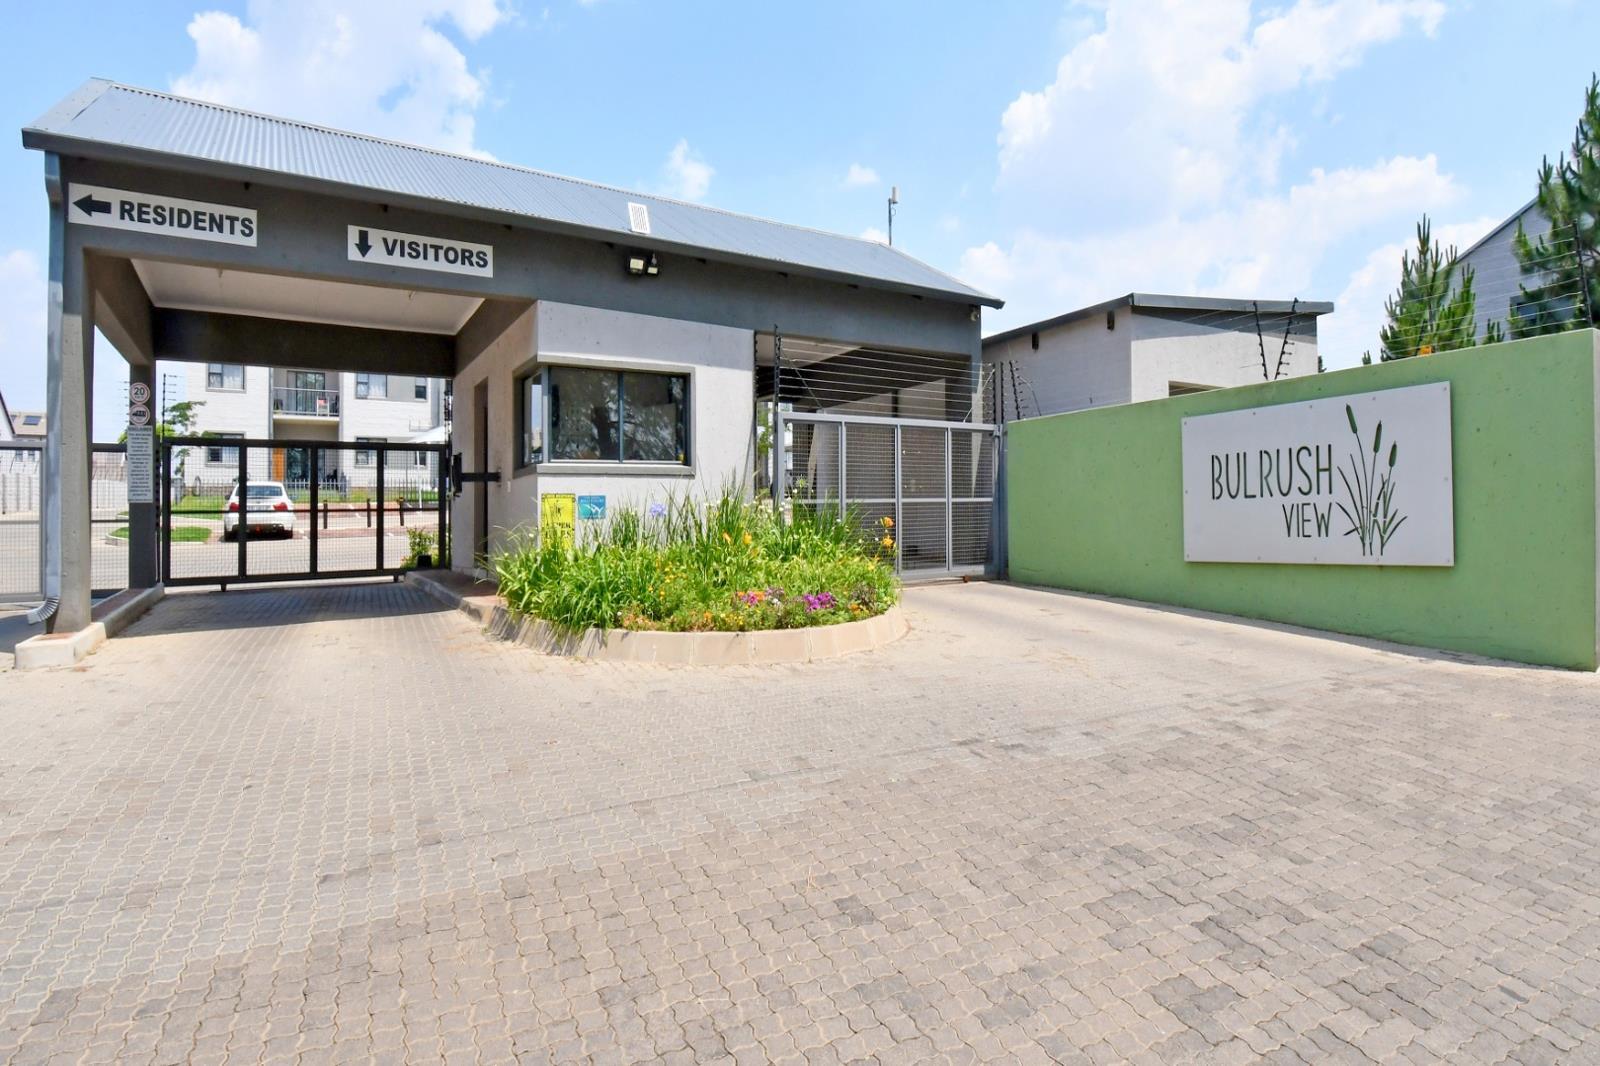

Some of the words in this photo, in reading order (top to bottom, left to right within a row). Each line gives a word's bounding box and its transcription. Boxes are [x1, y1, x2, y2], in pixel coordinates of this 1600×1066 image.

[119, 200, 254, 237] RESIDENTS
[382, 237, 488, 268] VISITORS
[134, 387, 145, 396] 20
[1211, 444, 1333, 500] BULRUSH
[1282, 502, 1332, 538] VIEW
